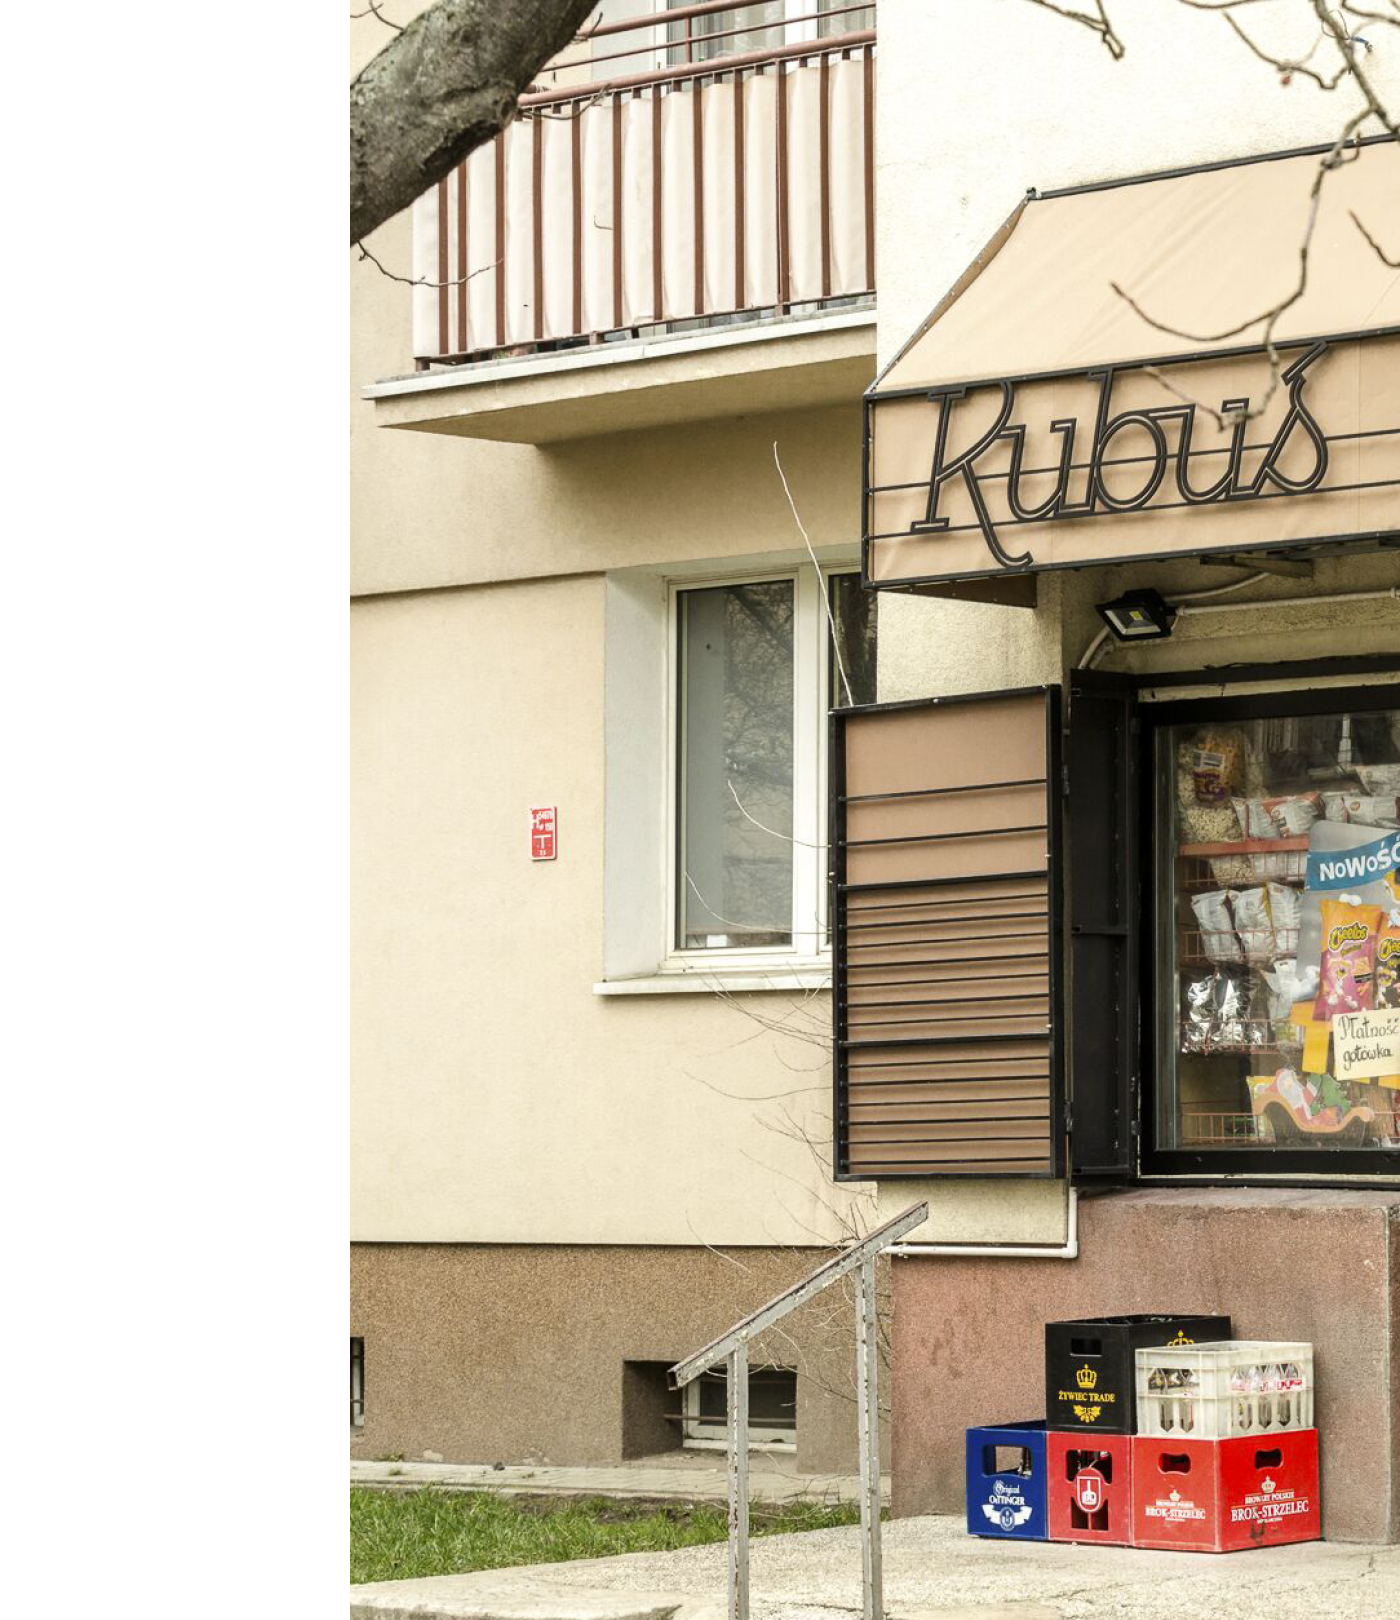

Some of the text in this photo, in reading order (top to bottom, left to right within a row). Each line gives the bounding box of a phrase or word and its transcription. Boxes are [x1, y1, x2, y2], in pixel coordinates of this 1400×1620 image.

[911, 341, 1329, 568] Kubuś
[1328, 921, 1369, 952] Cheetos
[1343, 1043, 1394, 1072] gotówka
[1058, 1389, 1116, 1403] ŻYWIEC TRADE
[1231, 1500, 1309, 1523] BROK-STRZELEC
